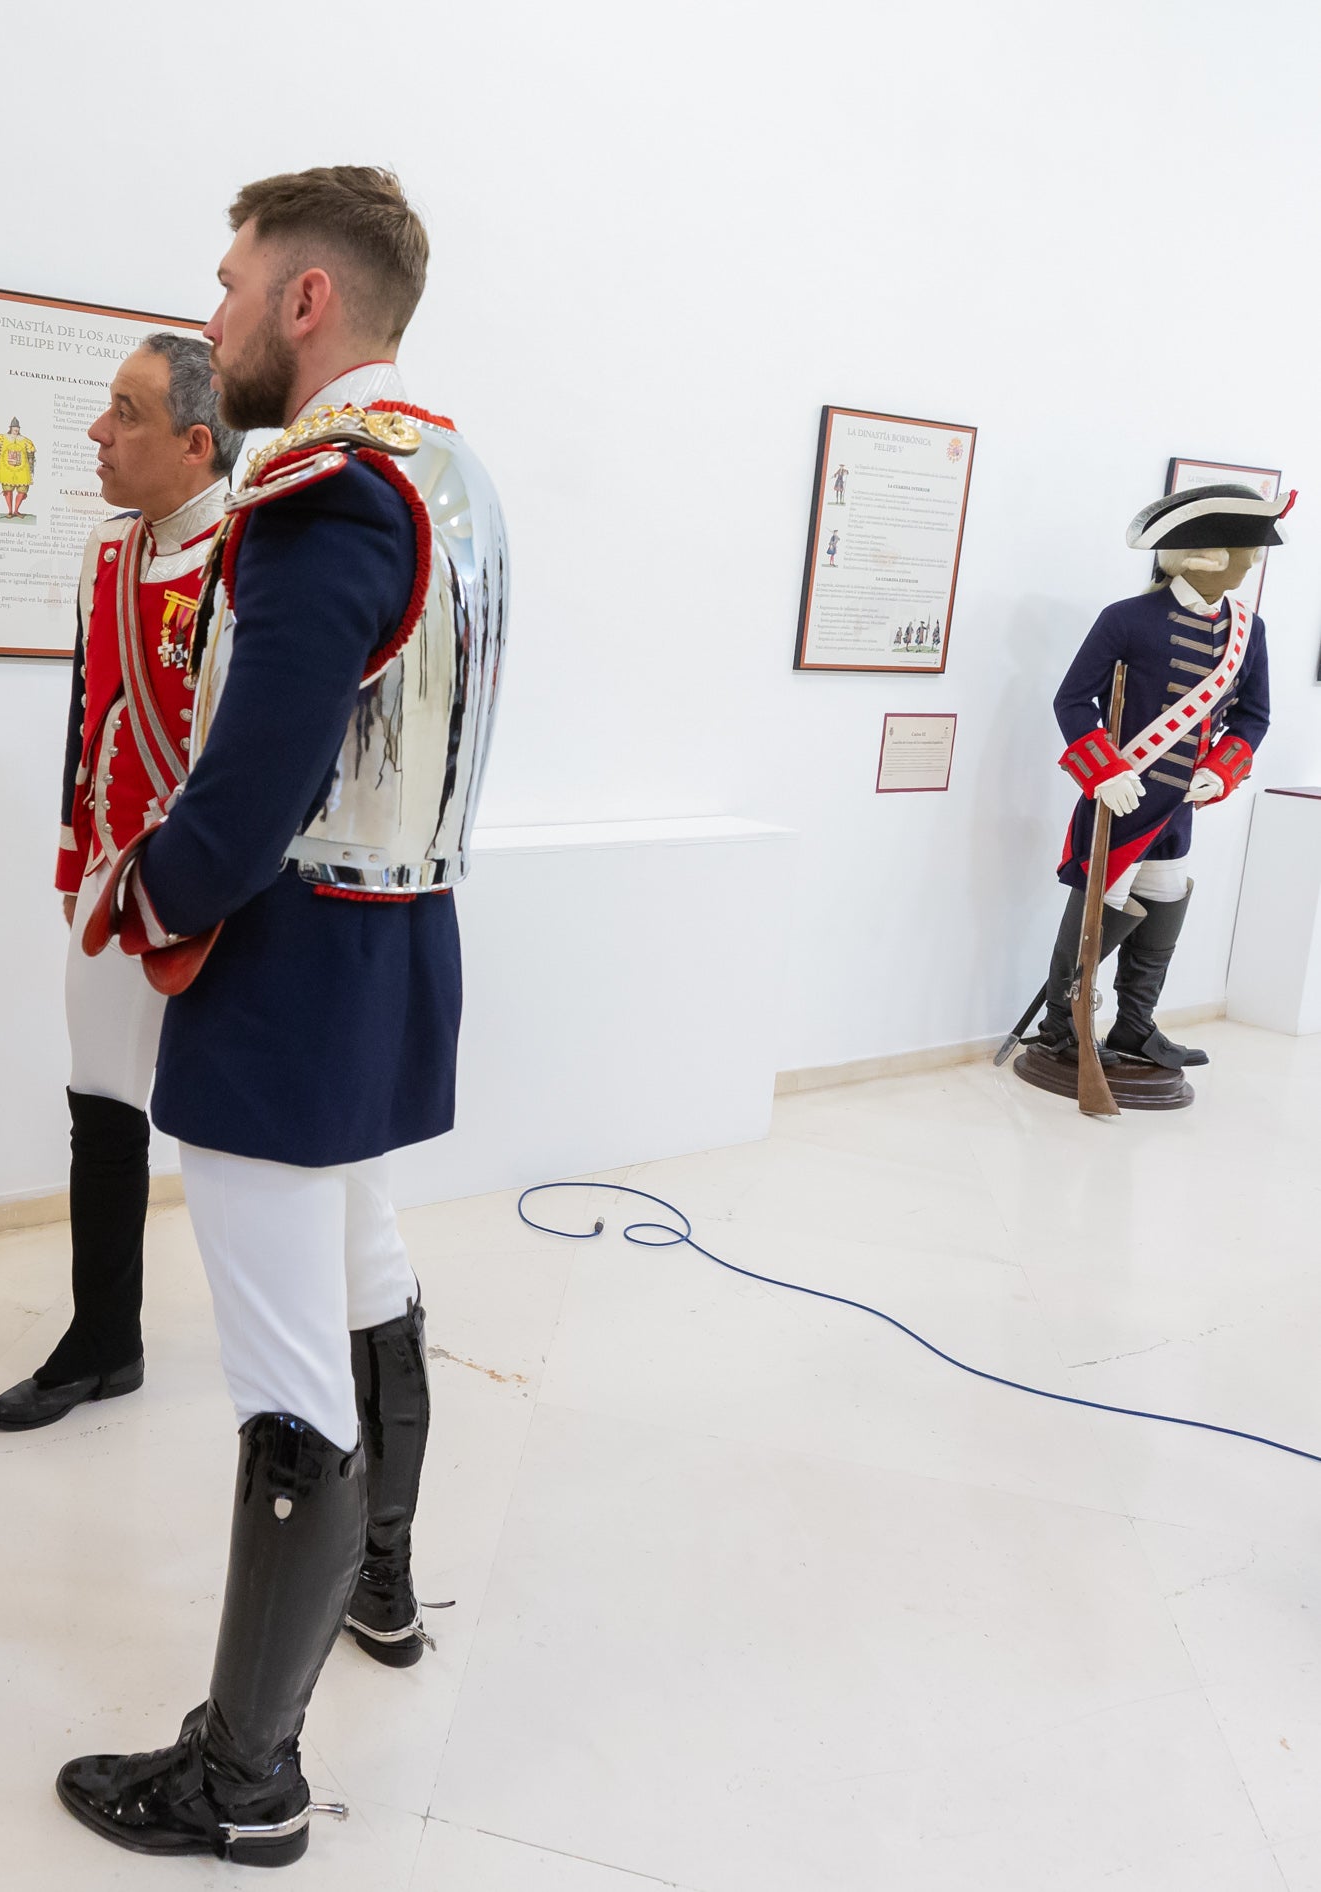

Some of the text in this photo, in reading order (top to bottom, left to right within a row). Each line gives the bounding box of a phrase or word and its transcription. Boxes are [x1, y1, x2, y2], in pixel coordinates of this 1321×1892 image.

[57, 325, 75, 337] DE
[78, 328, 103, 341] LOS
[10, 334, 128, 360] FELIPE IV Y CARLO
[20, 371, 54, 380] GUARDIA
